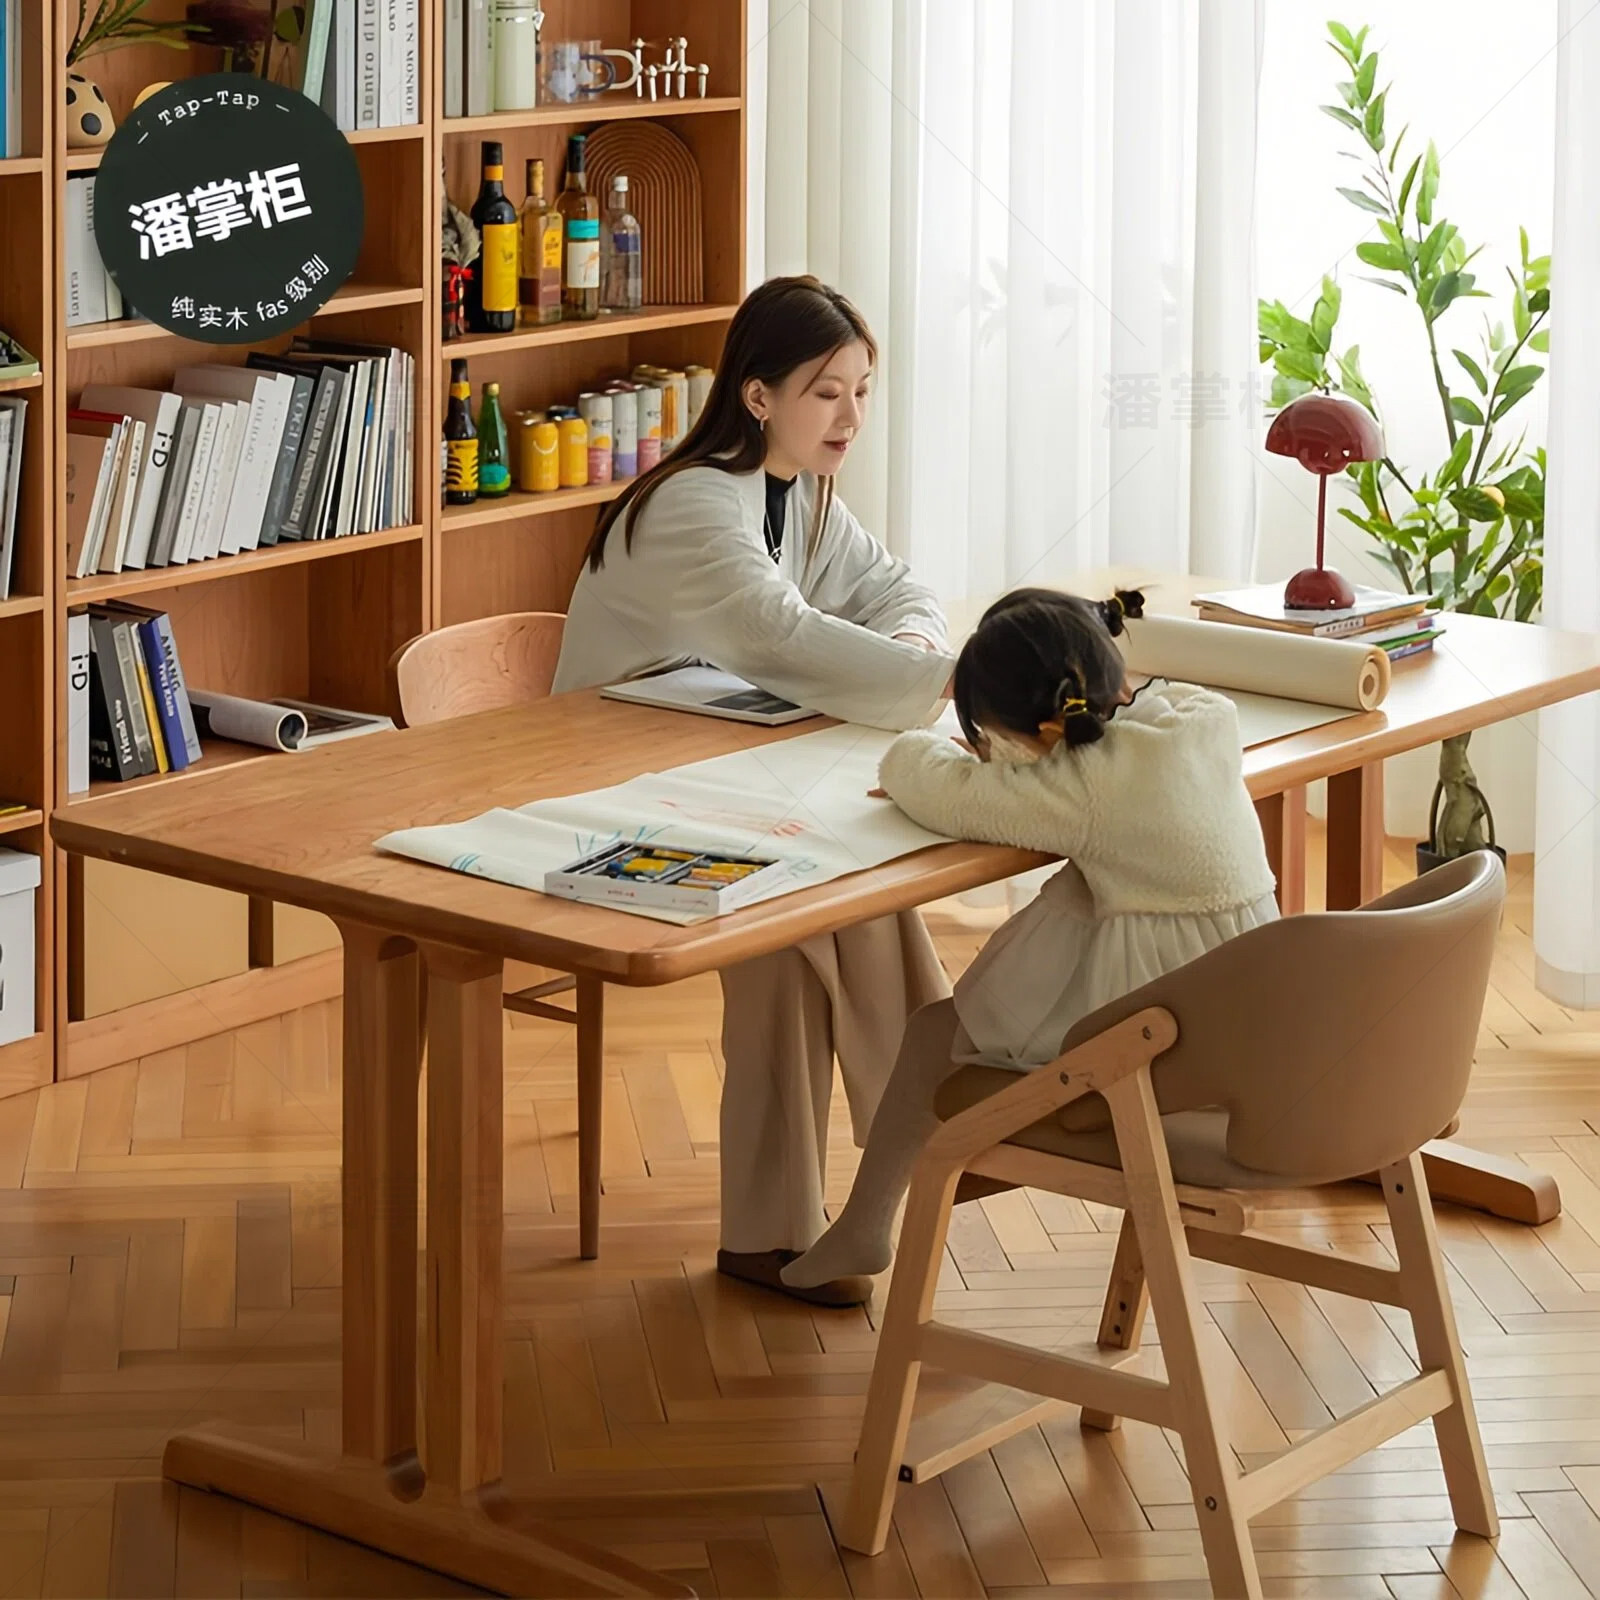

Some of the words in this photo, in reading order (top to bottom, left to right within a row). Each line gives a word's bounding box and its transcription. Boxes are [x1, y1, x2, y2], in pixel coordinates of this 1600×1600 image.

[405, 50, 414, 115] MONROE
[152, 431, 173, 468] i-D
[283, 391, 308, 458] VOGUE
[71, 654, 89, 691] i-D
